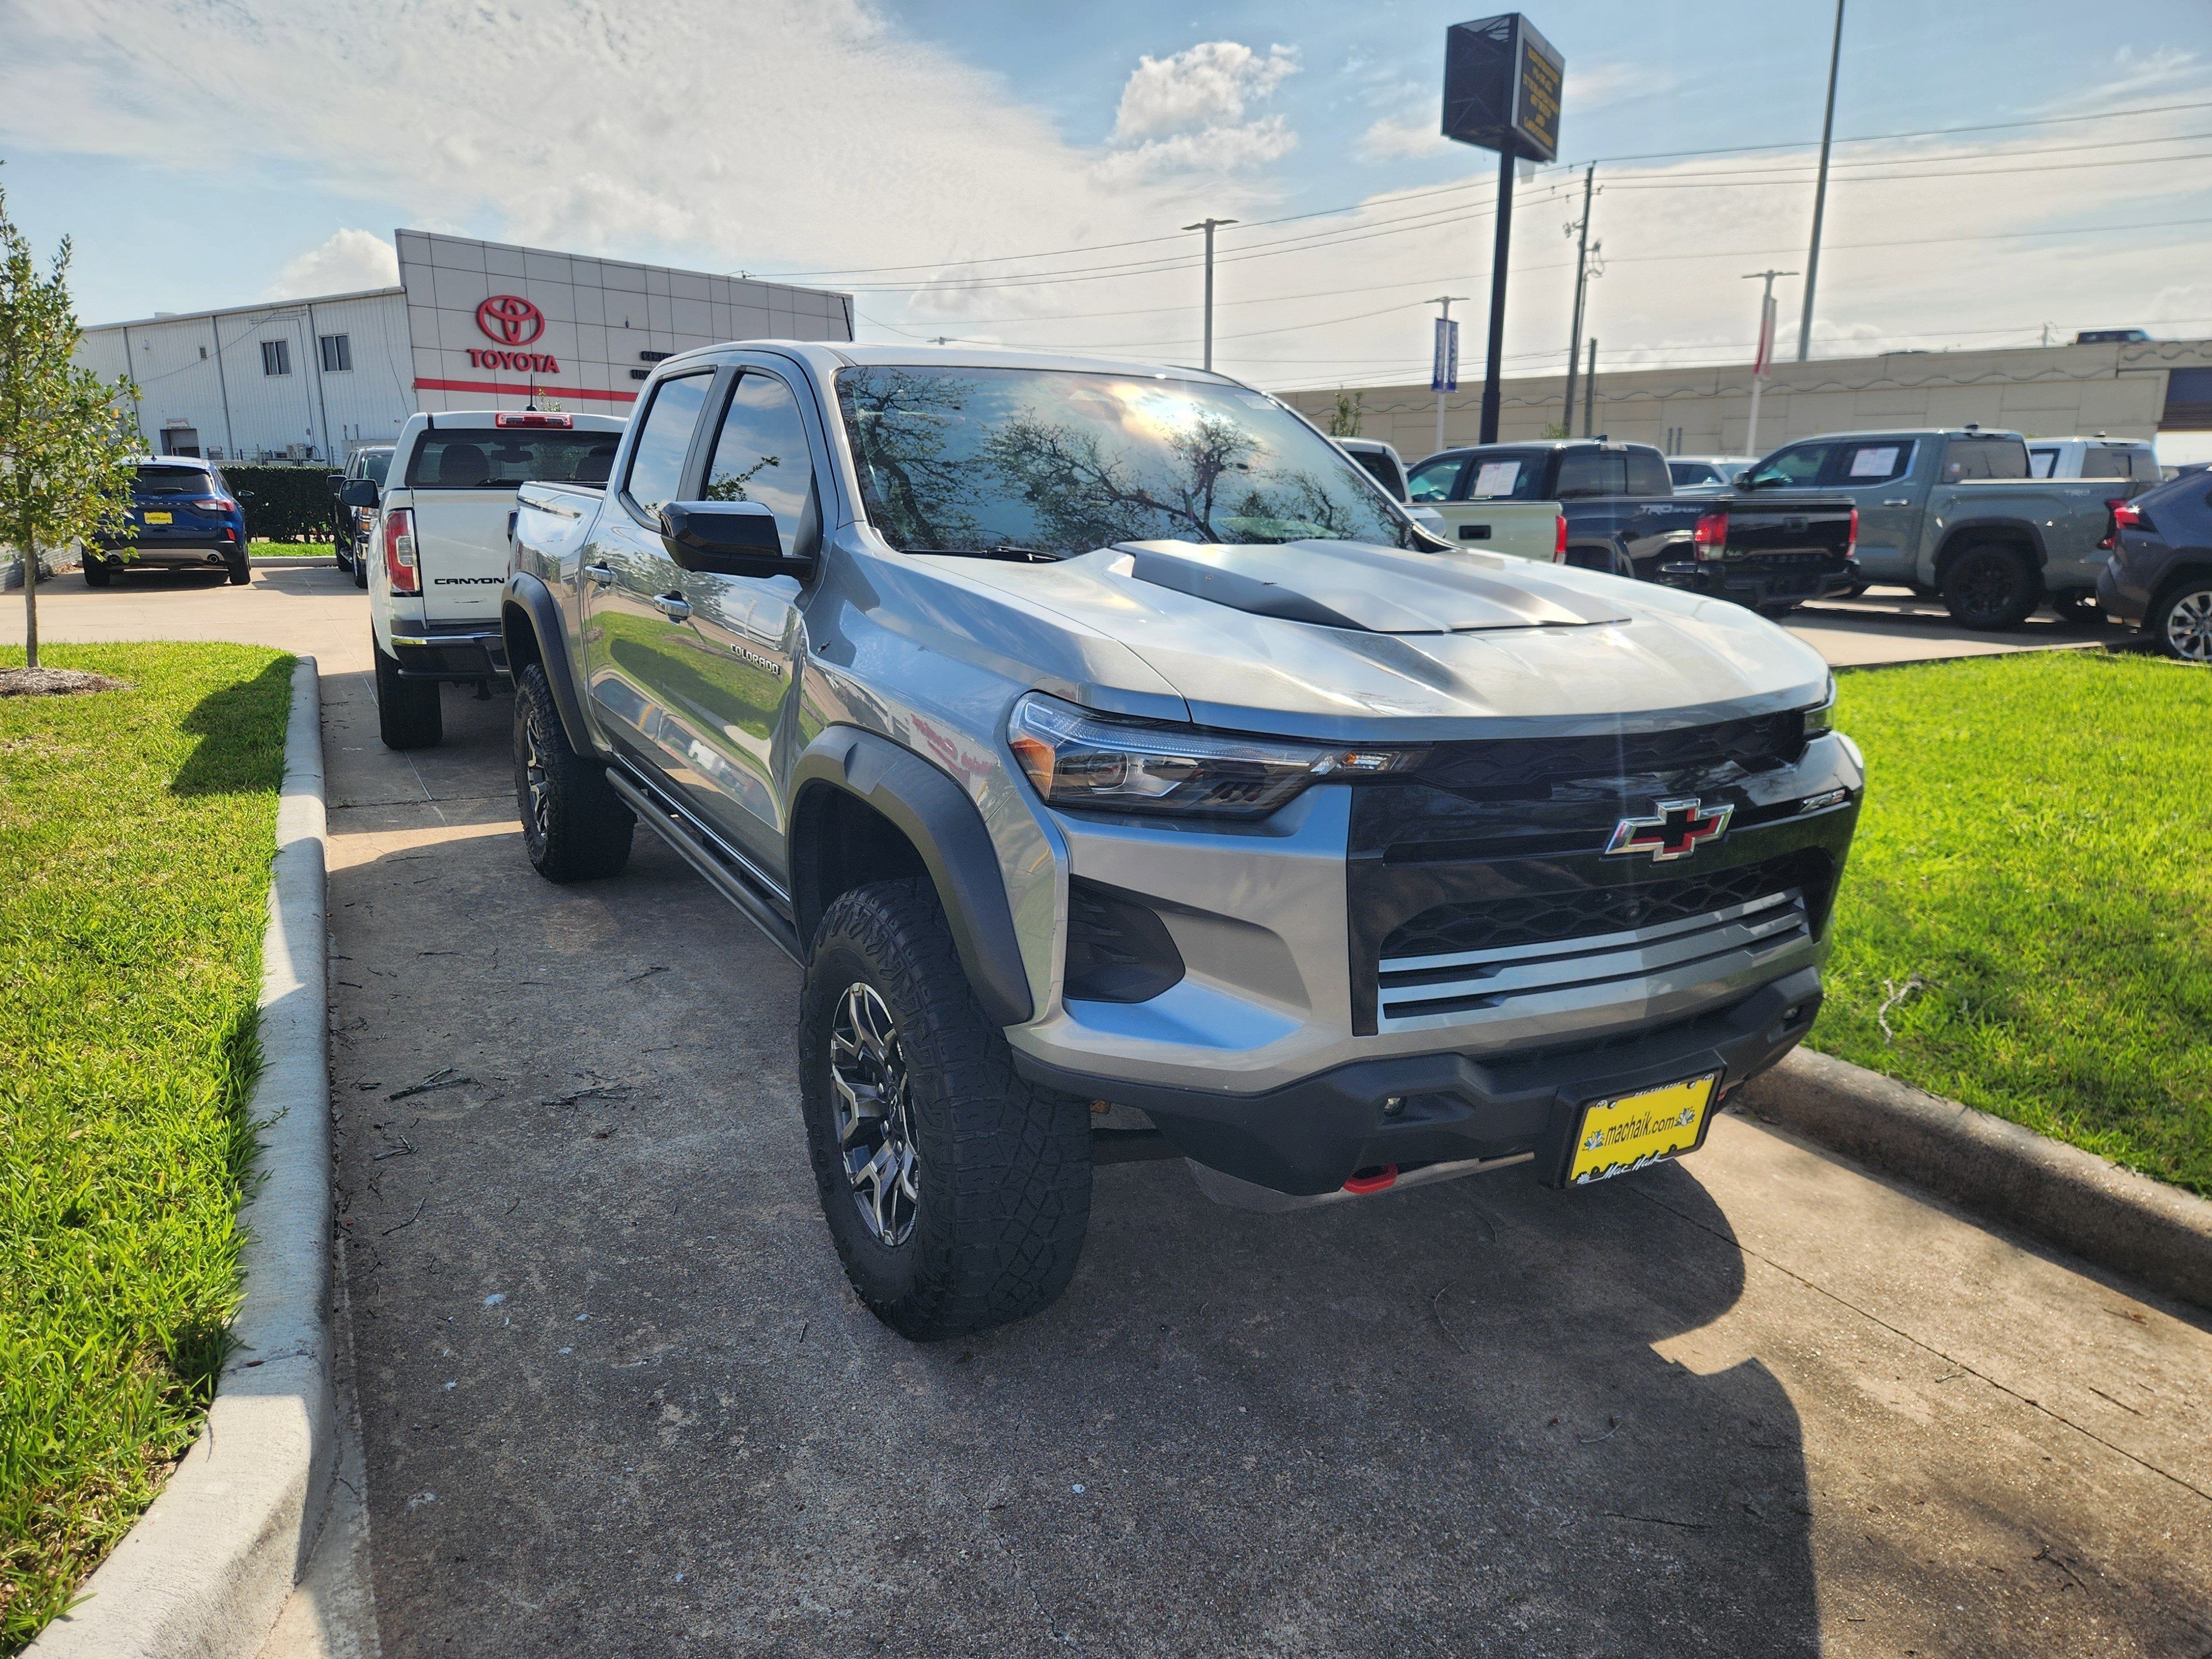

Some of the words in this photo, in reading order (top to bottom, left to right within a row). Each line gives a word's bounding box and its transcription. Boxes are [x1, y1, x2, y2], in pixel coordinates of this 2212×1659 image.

[467, 349, 560, 373] TOYOTA
[1640, 505, 1673, 515] TRD
[731, 643, 781, 675] COLORADO
[1604, 1111, 1674, 1146] machaik.com
[1604, 1164, 1629, 1180] Mac
[1631, 1151, 1661, 1171] Haik
